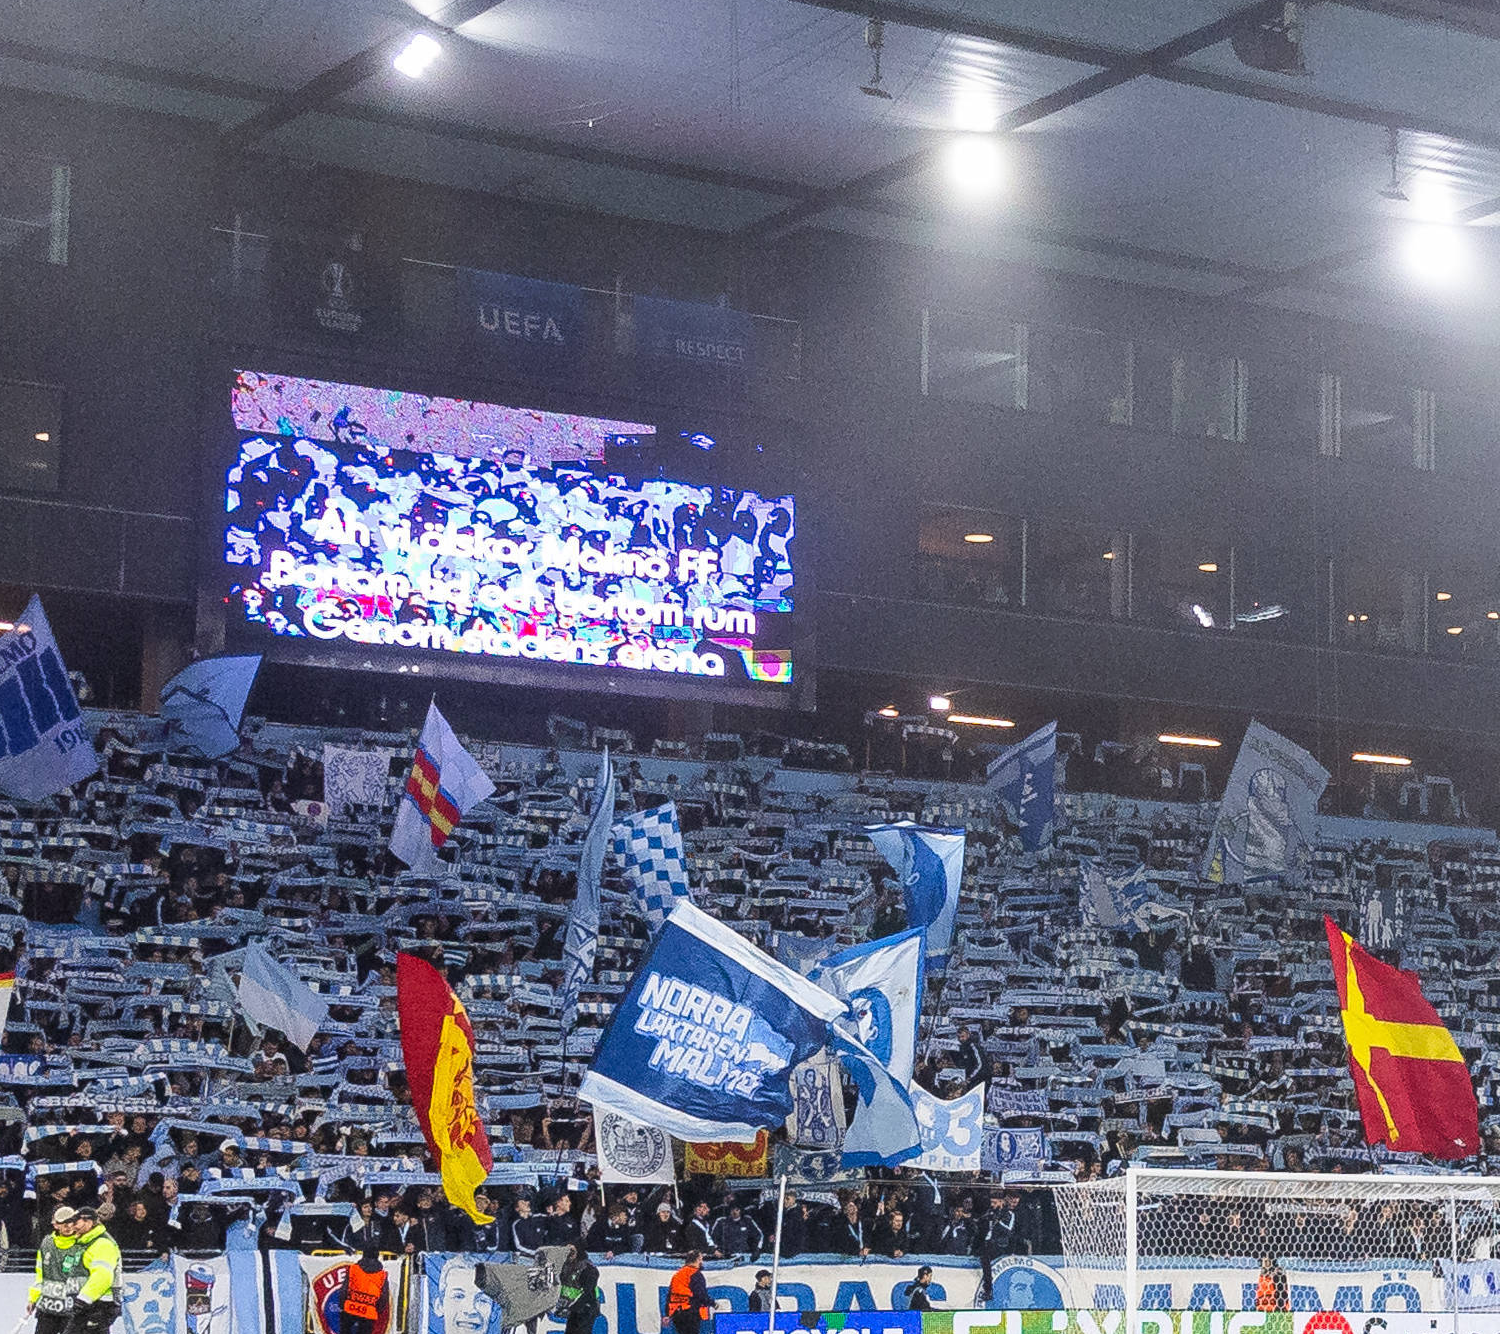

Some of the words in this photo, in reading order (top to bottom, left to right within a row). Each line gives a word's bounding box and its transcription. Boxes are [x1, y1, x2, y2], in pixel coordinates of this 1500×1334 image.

[477, 305, 564, 344] UEFA
[679, 549, 721, 583] FF
[693, 604, 757, 634] rum
[638, 972, 753, 1042] NORRA
[635, 1008, 750, 1064] LÄKTAREN
[649, 1038, 763, 1099] MALMÖ
